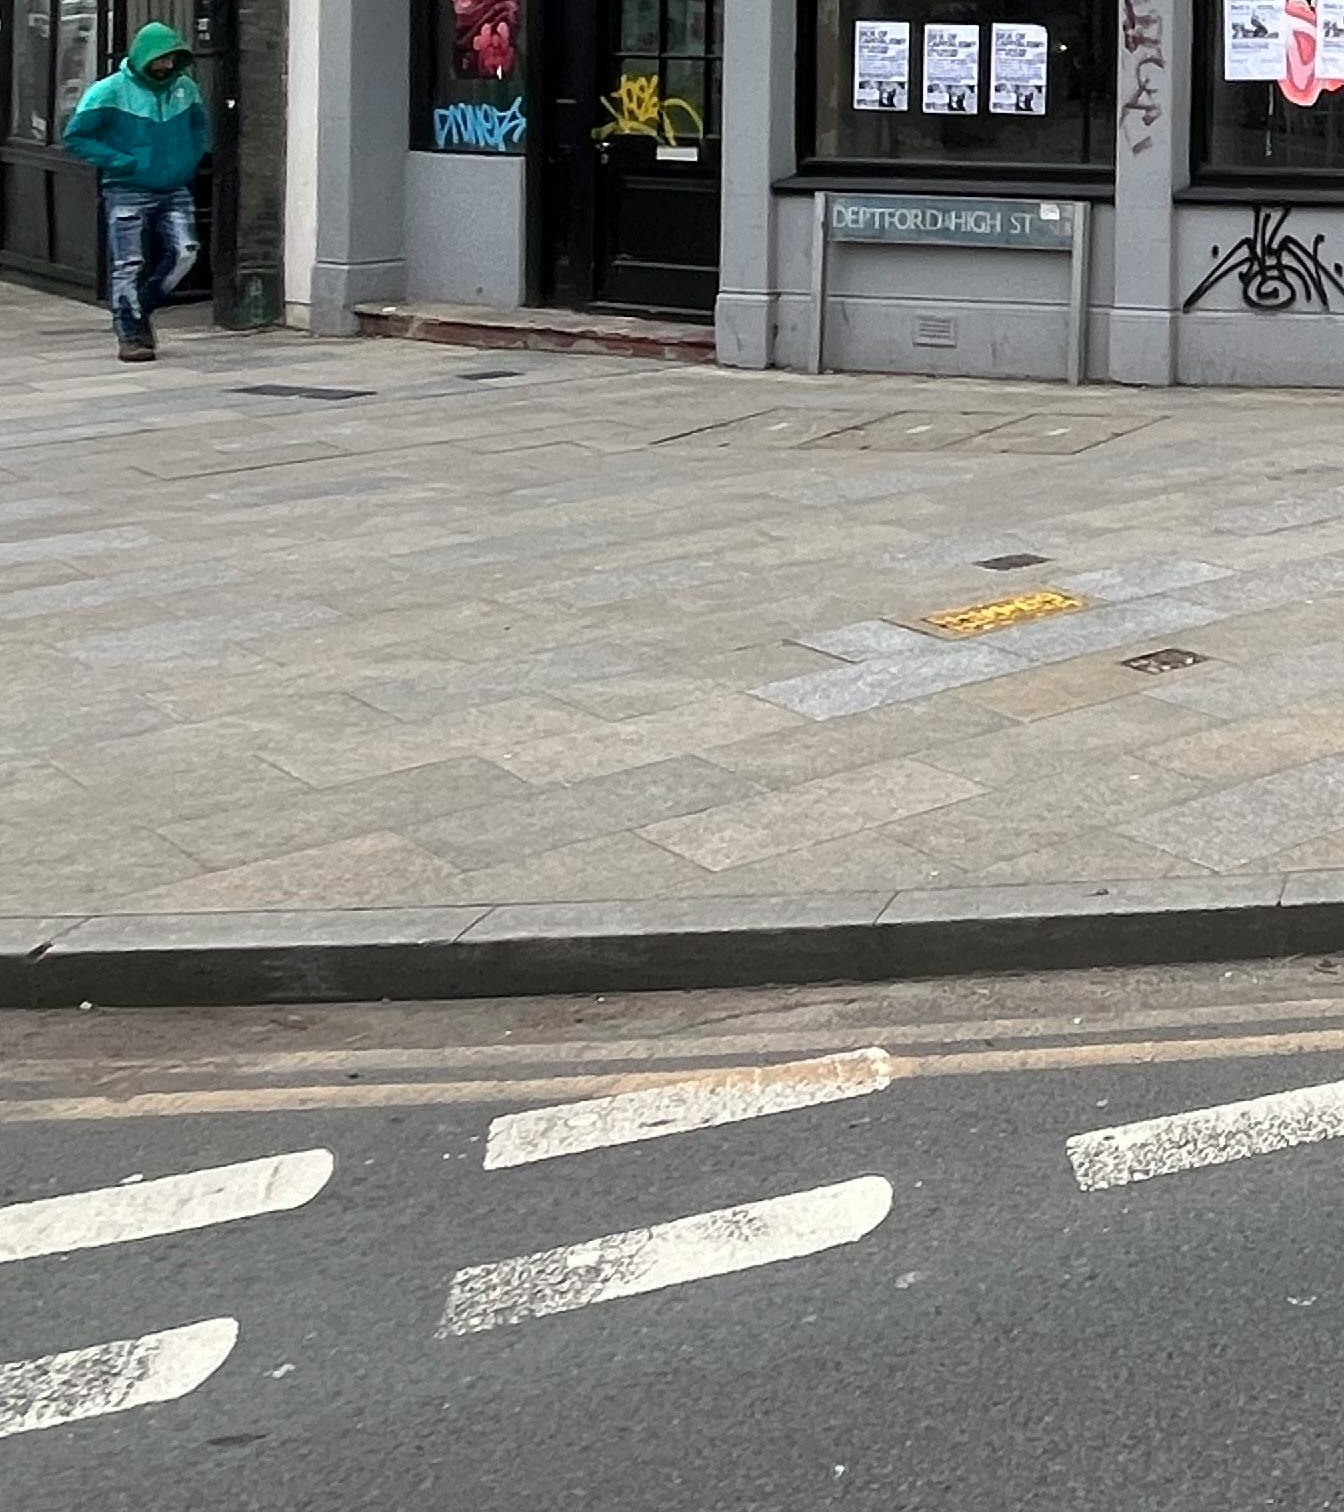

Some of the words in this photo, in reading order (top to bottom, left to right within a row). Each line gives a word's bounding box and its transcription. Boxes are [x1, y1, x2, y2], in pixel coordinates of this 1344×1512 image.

[831, 204, 943, 231] DEPTFORD
[949, 210, 1001, 234] HIGH
[1009, 213, 1034, 234] ST
